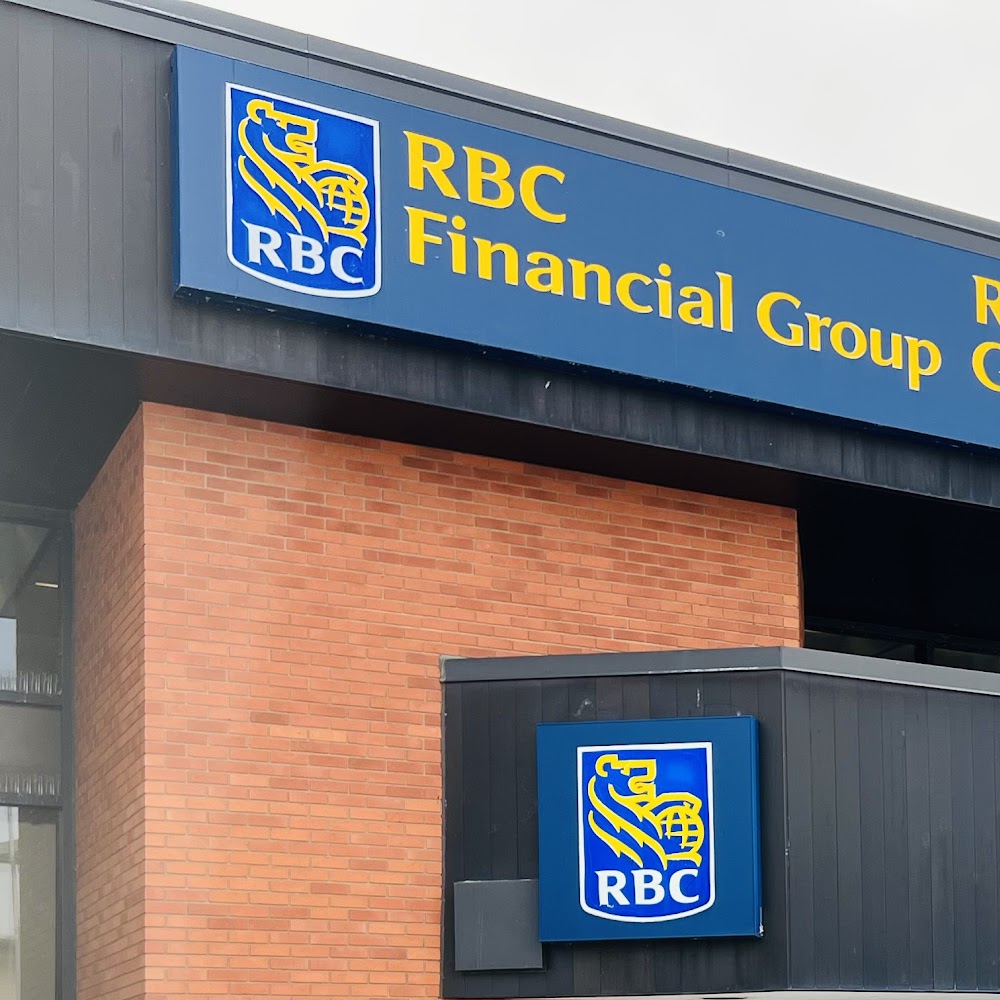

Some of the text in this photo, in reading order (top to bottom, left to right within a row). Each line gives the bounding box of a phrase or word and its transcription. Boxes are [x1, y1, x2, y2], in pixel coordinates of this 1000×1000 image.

[404, 130, 567, 224] RBC
[243, 219, 364, 285] RBC
[404, 205, 942, 391] Financial Group
[594, 868, 700, 908] RBC
